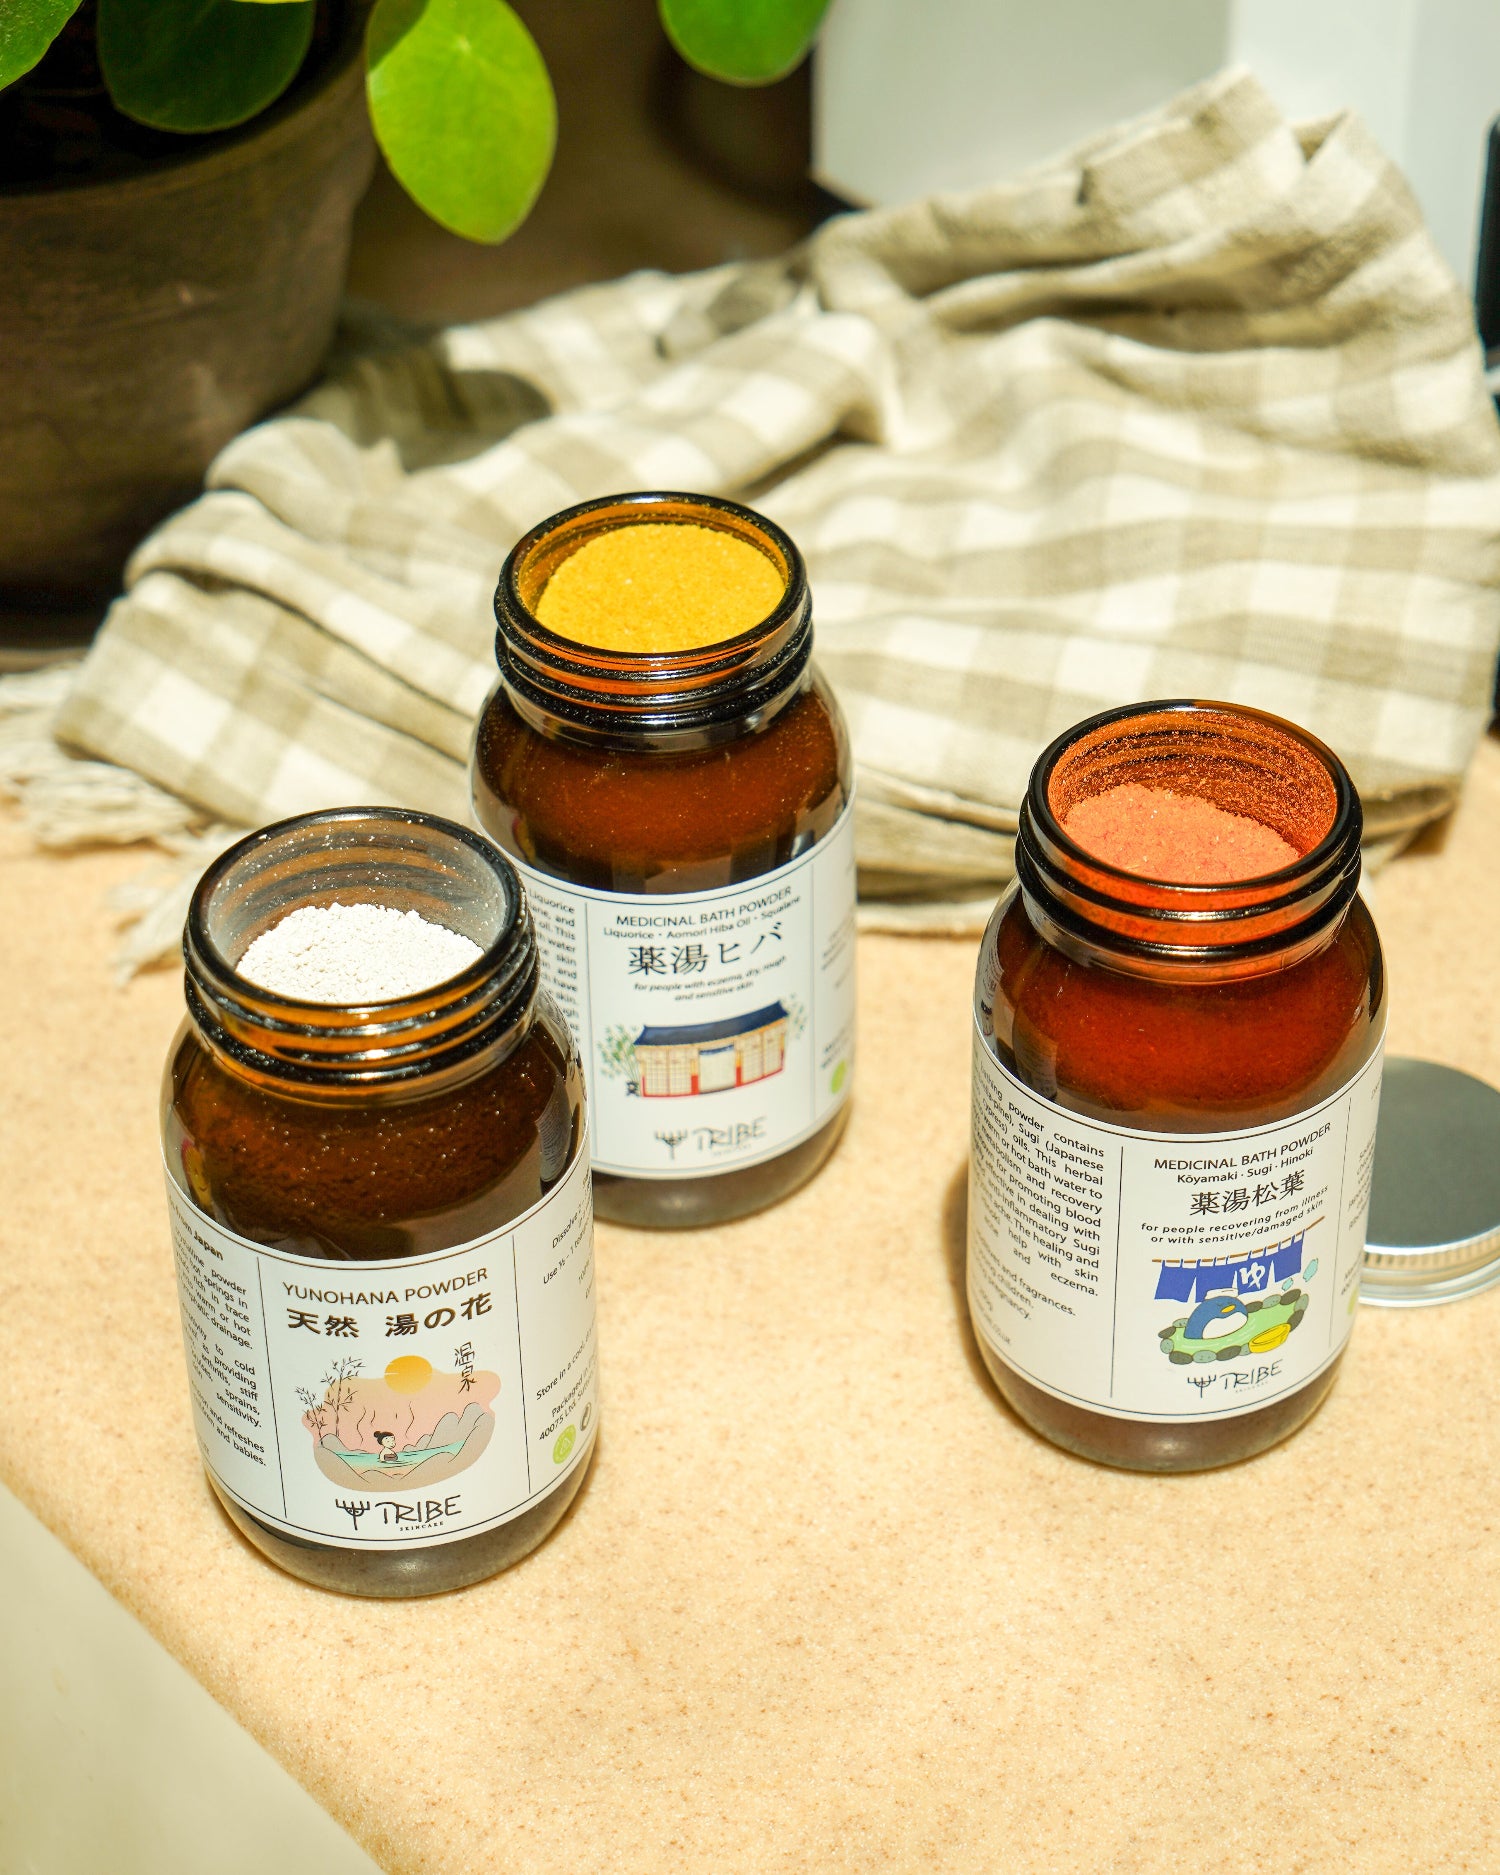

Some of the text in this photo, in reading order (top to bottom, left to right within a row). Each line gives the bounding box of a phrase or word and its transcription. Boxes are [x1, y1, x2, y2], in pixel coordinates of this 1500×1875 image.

[529, 888, 575, 913] Liquorice
[616, 885, 792, 927] MEDICINAL BATH POWDER
[556, 915, 575, 927] and
[556, 926, 575, 940] This
[603, 927, 655, 939] Liquorice
[666, 928, 708, 939] Aomori
[709, 923, 734, 934] Hiba
[736, 917, 752, 929] Oil
[548, 939, 575, 952] water
[556, 953, 577, 967] skin
[628, 920, 783, 976] 薬湯ヒバ
[554, 977, 578, 992] have
[558, 967, 577, 980] and
[634, 982, 648, 991] for
[649, 982, 682, 992] people
[685, 980, 706, 991] with
[674, 980, 754, 1001] and sensitive skin
[692, 1115, 767, 1151] TRIBE
[1008, 1101, 1045, 1133] powder
[1053, 1132, 1105, 1158] contains
[1018, 1123, 1040, 1145] Sugi
[1045, 1140, 1104, 1172] (Japanese
[1153, 1122, 1331, 1171] MEDICINAL BATH POWDER
[1001, 1138, 1010, 1149] or
[1011, 1144, 1026, 1165] hot
[1028, 1158, 1051, 1180] bath
[1053, 1173, 1087, 1195] water
[1089, 1187, 1103, 1200] to
[1012, 1134, 1030, 1152] oils.
[1035, 1147, 1057, 1168] This
[1064, 1163, 1103, 1186] herbal
[1177, 1146, 1314, 1186] Kōyamaki Sugi Hinoki
[996, 1157, 1008, 1176] for
[1009, 1173, 1061, 1214] promoting
[1065, 1206, 1102, 1228] blood
[1026, 1172, 1046, 1191] and
[1051, 1187, 1103, 1215] recovery
[1141, 1184, 1329, 1235] for people recovering from illness
[1189, 1169, 1306, 1217] 薬湯松葉
[1017, 1192, 1026, 1206] in
[1029, 1202, 1070, 1232] dealing
[1073, 1224, 1100, 1242] with
[1150, 1198, 1324, 1244] or with sensitive/damaged skin
[194, 1229, 223, 1261] Japan
[1008, 1226, 1028, 1249] help
[1037, 1249, 1062, 1269] with
[1074, 1267, 1099, 1282] skin
[1014, 1217, 1031, 1237] The
[1033, 1231, 1073, 1260] healing
[1075, 1254, 1099, 1269] and
[1073, 1238, 1100, 1256] Sugi
[211, 1269, 247, 1296] powder
[282, 1267, 488, 1305] YUNOHANA POWDER
[543, 1267, 558, 1285] Use
[1013, 1247, 1031, 1265] and
[1050, 1271, 1099, 1297] eczema.
[1239, 1261, 1266, 1290] ゆ
[194, 1275, 206, 1292] rich
[211, 1291, 220, 1304] in
[225, 1302, 250, 1323] trace
[204, 1274, 235, 1302] springs
[238, 1297, 248, 1310] in
[1019, 1277, 1077, 1317] fragrances.
[196, 1288, 216, 1314] warm
[220, 1311, 229, 1323] or
[233, 1319, 251, 1336] hot
[286, 1291, 493, 1338] 天然 湯の花
[211, 1316, 253, 1349] drainage.
[214, 1355, 257, 1390] providing
[215, 1343, 255, 1376] to cold
[454, 1341, 477, 1394] 温泉
[1219, 1358, 1284, 1390] TRIBE
[225, 1388, 260, 1415] sprains,
[239, 1386, 258, 1402] stiff
[536, 1376, 558, 1400] Store
[559, 1368, 566, 1381] in
[551, 1373, 583, 1418] Packaged
[216, 1392, 262, 1428] sensitivity.
[539, 1415, 564, 1441] 40075
[216, 1427, 231, 1444] and
[233, 1439, 267, 1467] babies.
[224, 1420, 265, 1453] refreshes
[375, 1494, 462, 1524] TRIBE
[399, 1520, 445, 1531] SKINCARE
